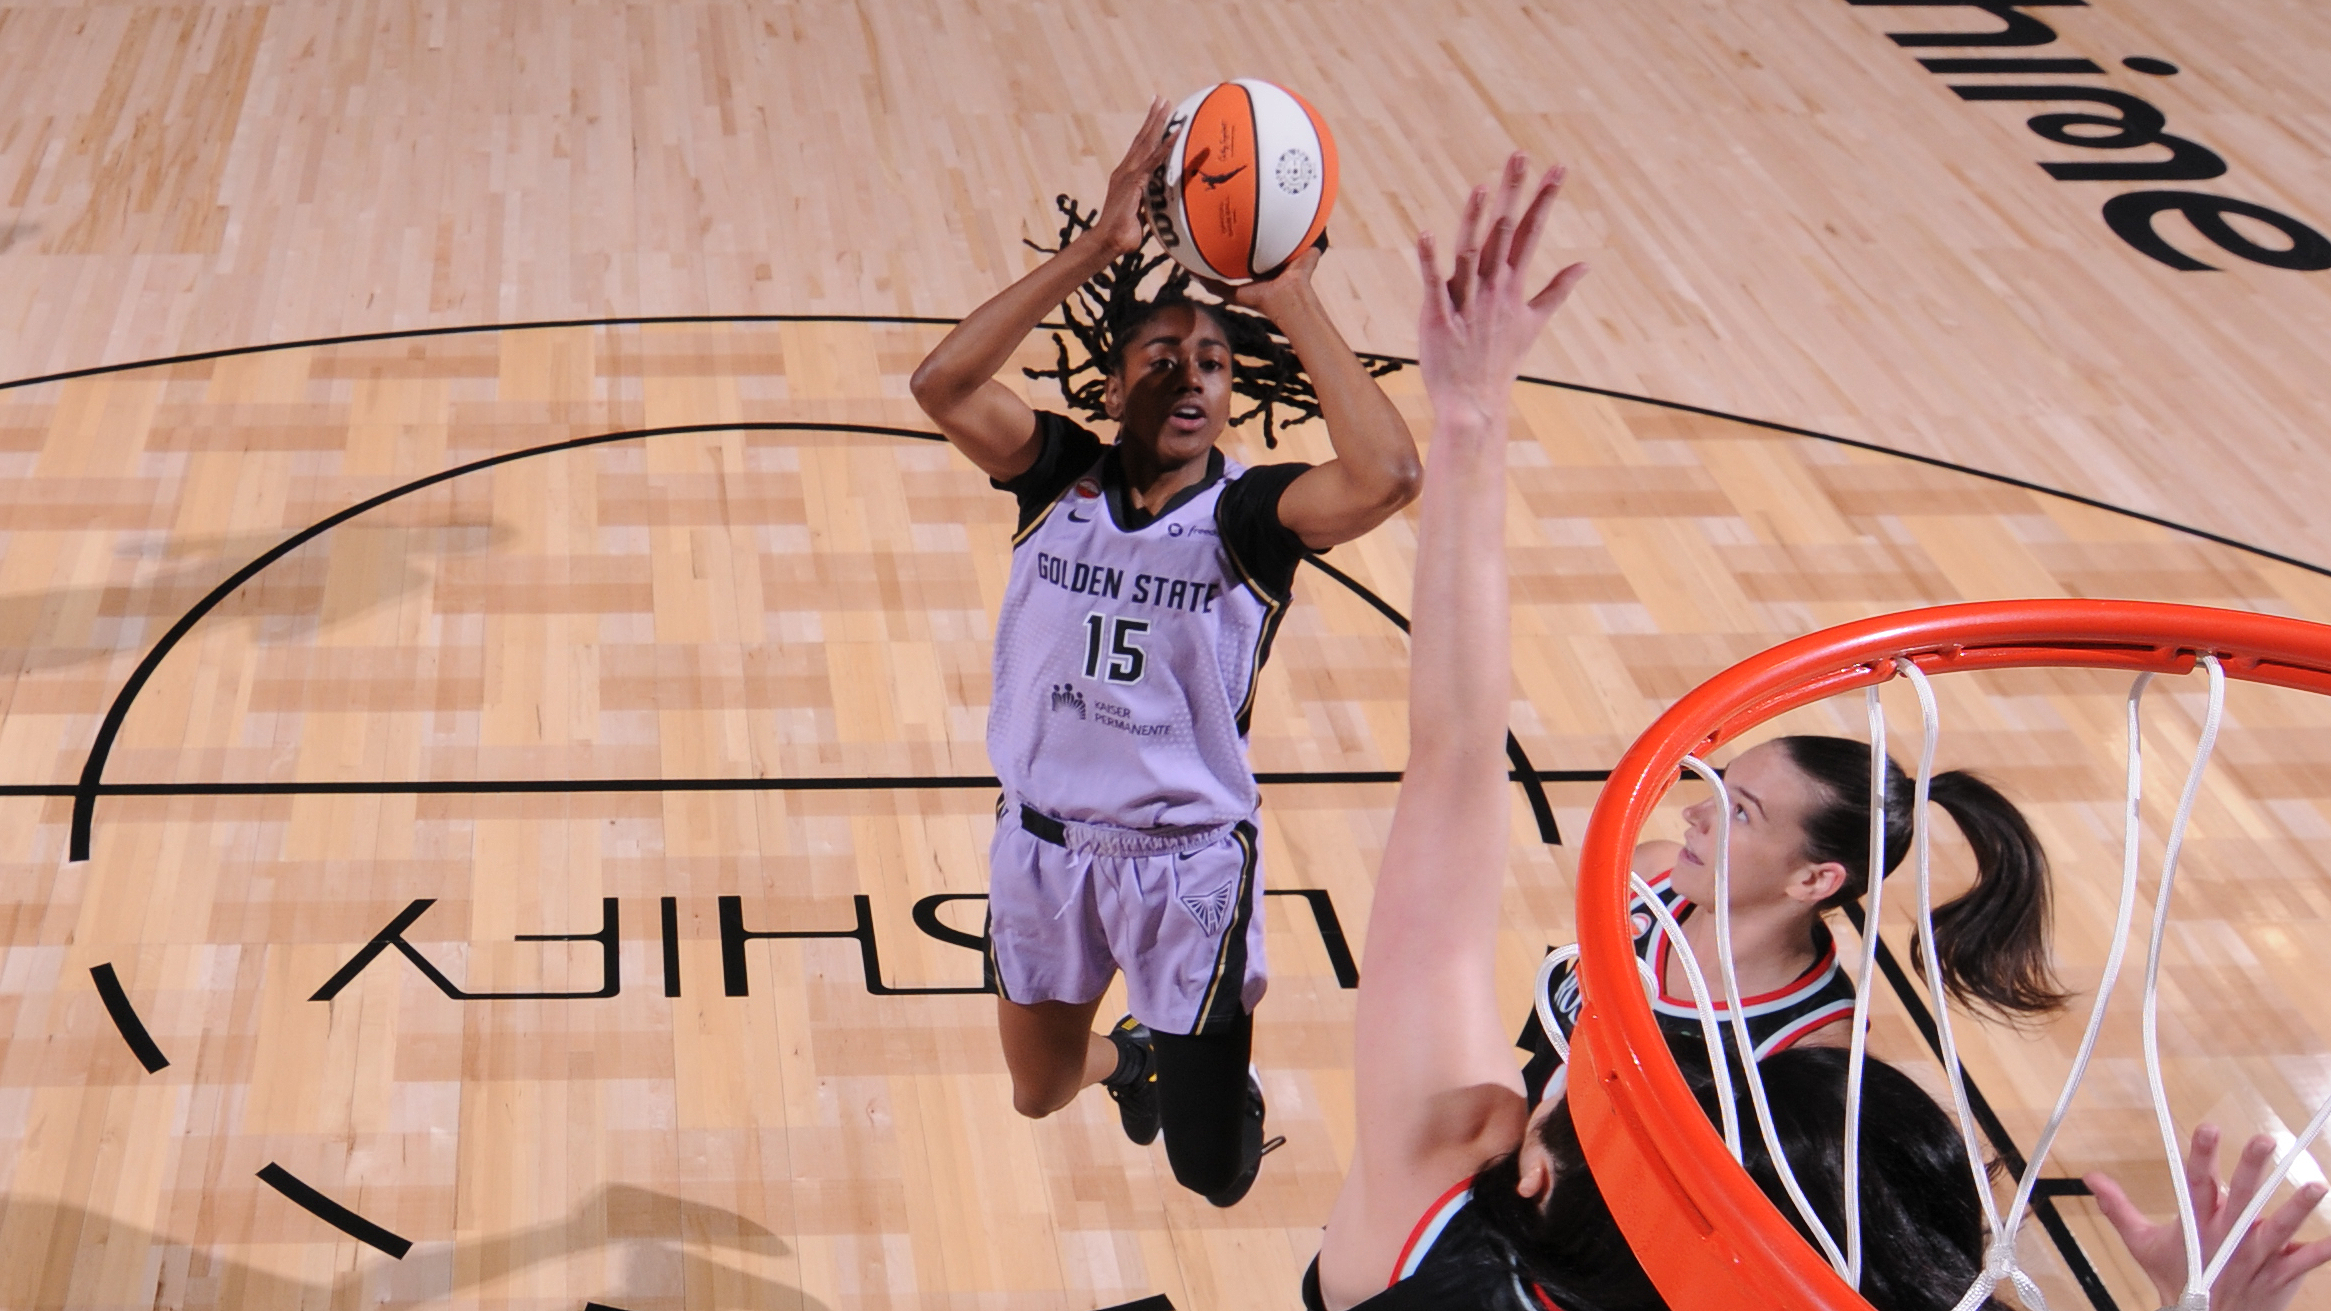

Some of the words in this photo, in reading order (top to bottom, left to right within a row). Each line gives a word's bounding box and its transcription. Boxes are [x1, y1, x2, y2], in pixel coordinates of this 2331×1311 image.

[1037, 552, 1124, 600] GOLDEN
[1131, 573, 1221, 614] STATE
[1082, 610, 1150, 685] 15
[1094, 700, 1131, 719] KAISER
[1094, 712, 1172, 735] PERMANENTE
[308, 890, 1361, 1001] LSHIFY
